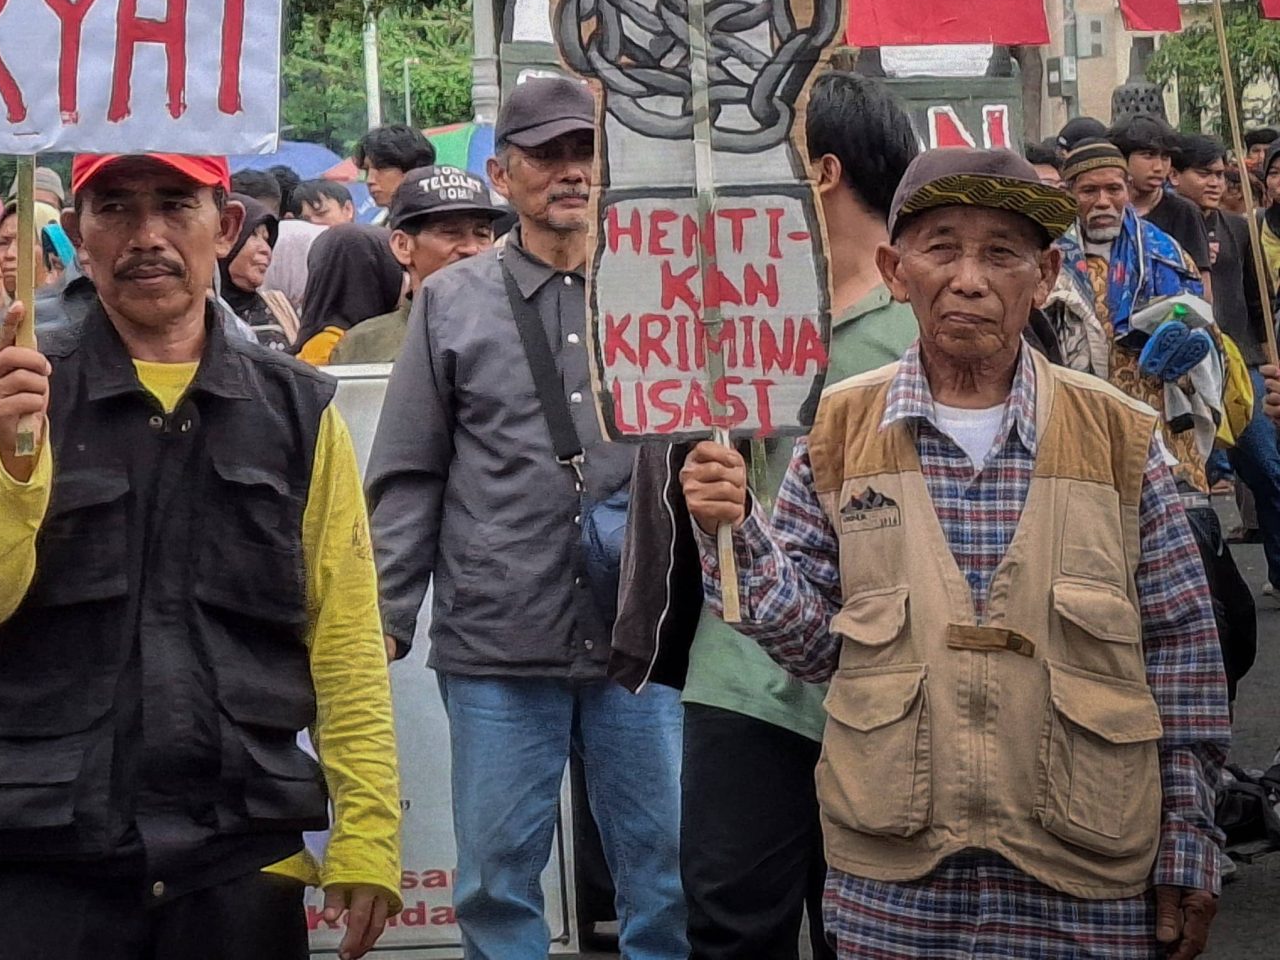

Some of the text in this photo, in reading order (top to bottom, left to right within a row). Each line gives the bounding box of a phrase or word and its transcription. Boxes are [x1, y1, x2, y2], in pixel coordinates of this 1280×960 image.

[418, 174, 482, 194] TELOLET
[607, 206, 811, 259] HENTI-
[660, 260, 779, 312] KAN
[604, 314, 829, 377] KRIMINA
